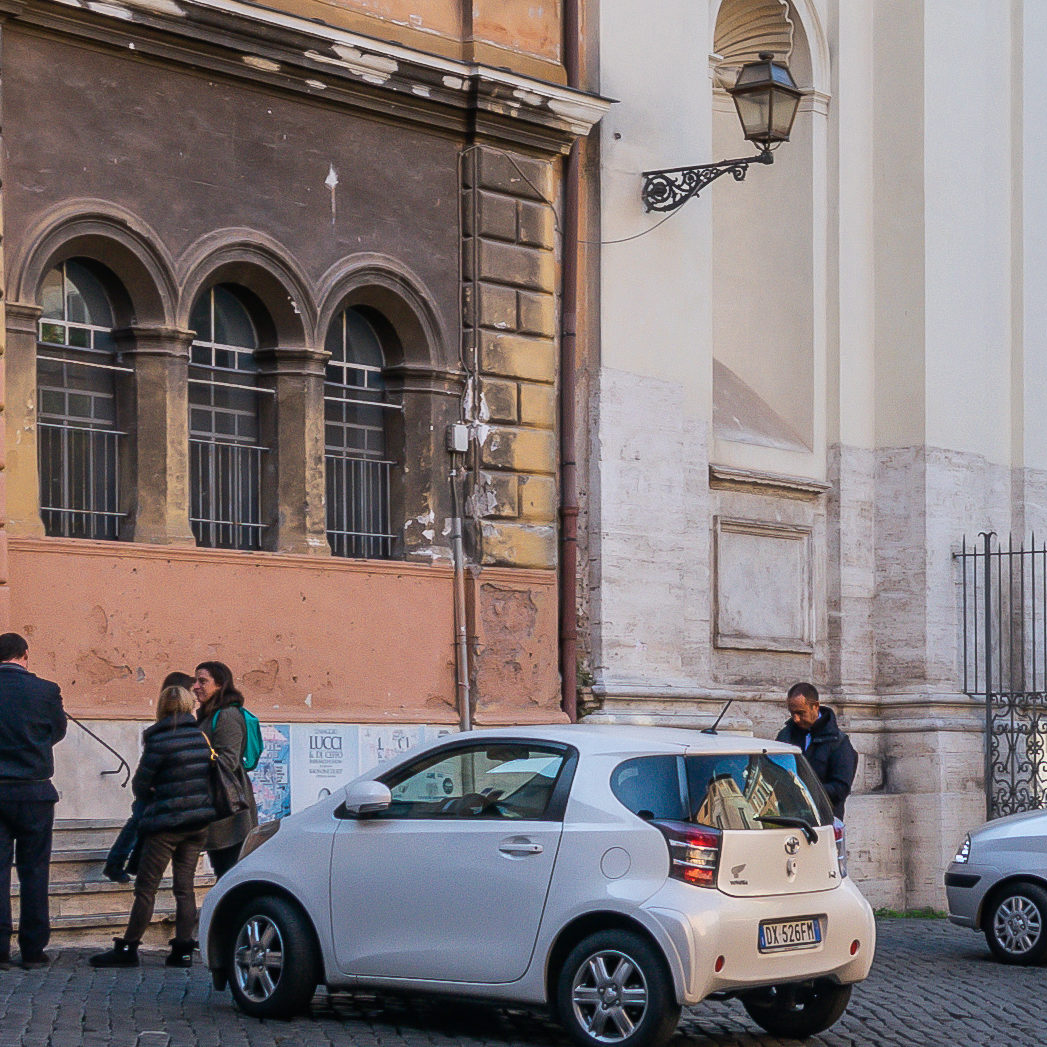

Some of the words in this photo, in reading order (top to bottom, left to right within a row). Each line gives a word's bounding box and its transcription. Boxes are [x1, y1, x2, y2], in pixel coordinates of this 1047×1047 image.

[309, 735, 342, 750] LUCCI
[765, 925, 780, 945] DX
[781, 921, 815, 943] 526FM
